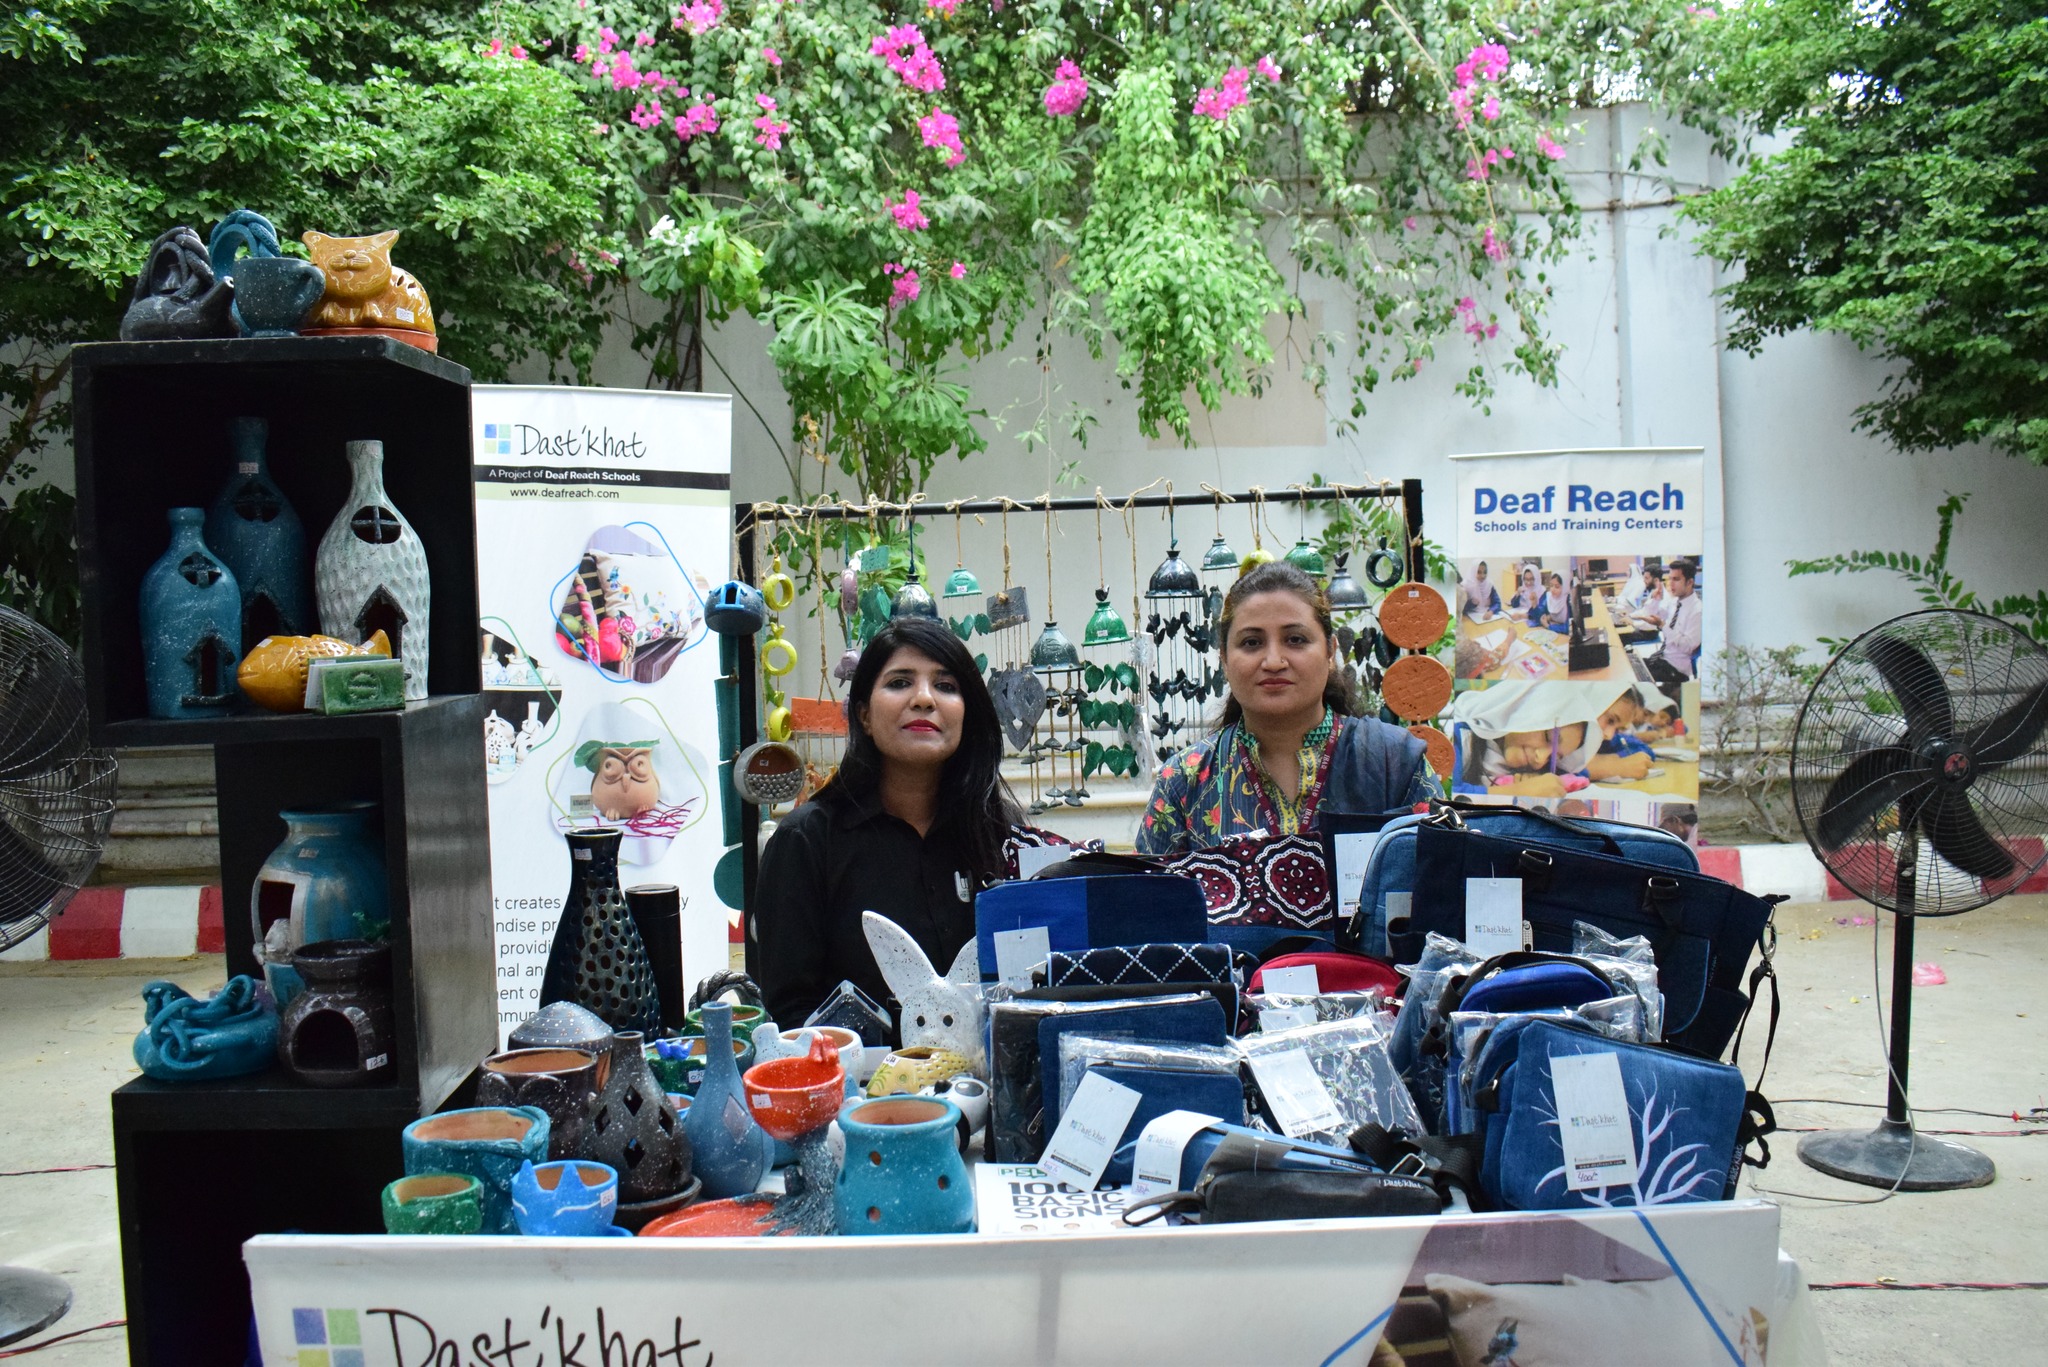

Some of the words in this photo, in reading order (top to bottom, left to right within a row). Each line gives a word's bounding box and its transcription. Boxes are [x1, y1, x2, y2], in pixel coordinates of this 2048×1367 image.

[514, 424, 647, 458] Dast'khat
[488, 470, 497, 478] A
[499, 469, 532, 480] Project
[533, 469, 544, 479] of
[545, 470, 569, 480] Deaf
[570, 471, 600, 480] Reach
[602, 471, 641, 482] Schools
[510, 487, 620, 499] www.deafreach.com
[1474, 485, 1556, 515] Deaf
[1568, 482, 1684, 513] Reach
[1474, 519, 1527, 533] Schools
[1532, 518, 1557, 531] and
[1562, 517, 1620, 532] Training
[1625, 517, 1683, 530] Centers
[504, 896, 561, 910] creates
[525, 965, 546, 978] an
[498, 986, 525, 1000] ent
[1000, 1167, 1048, 1179] PSL
[1012, 1192, 1125, 1206] BASIC
[1014, 1203, 1129, 1219] SIGNS
